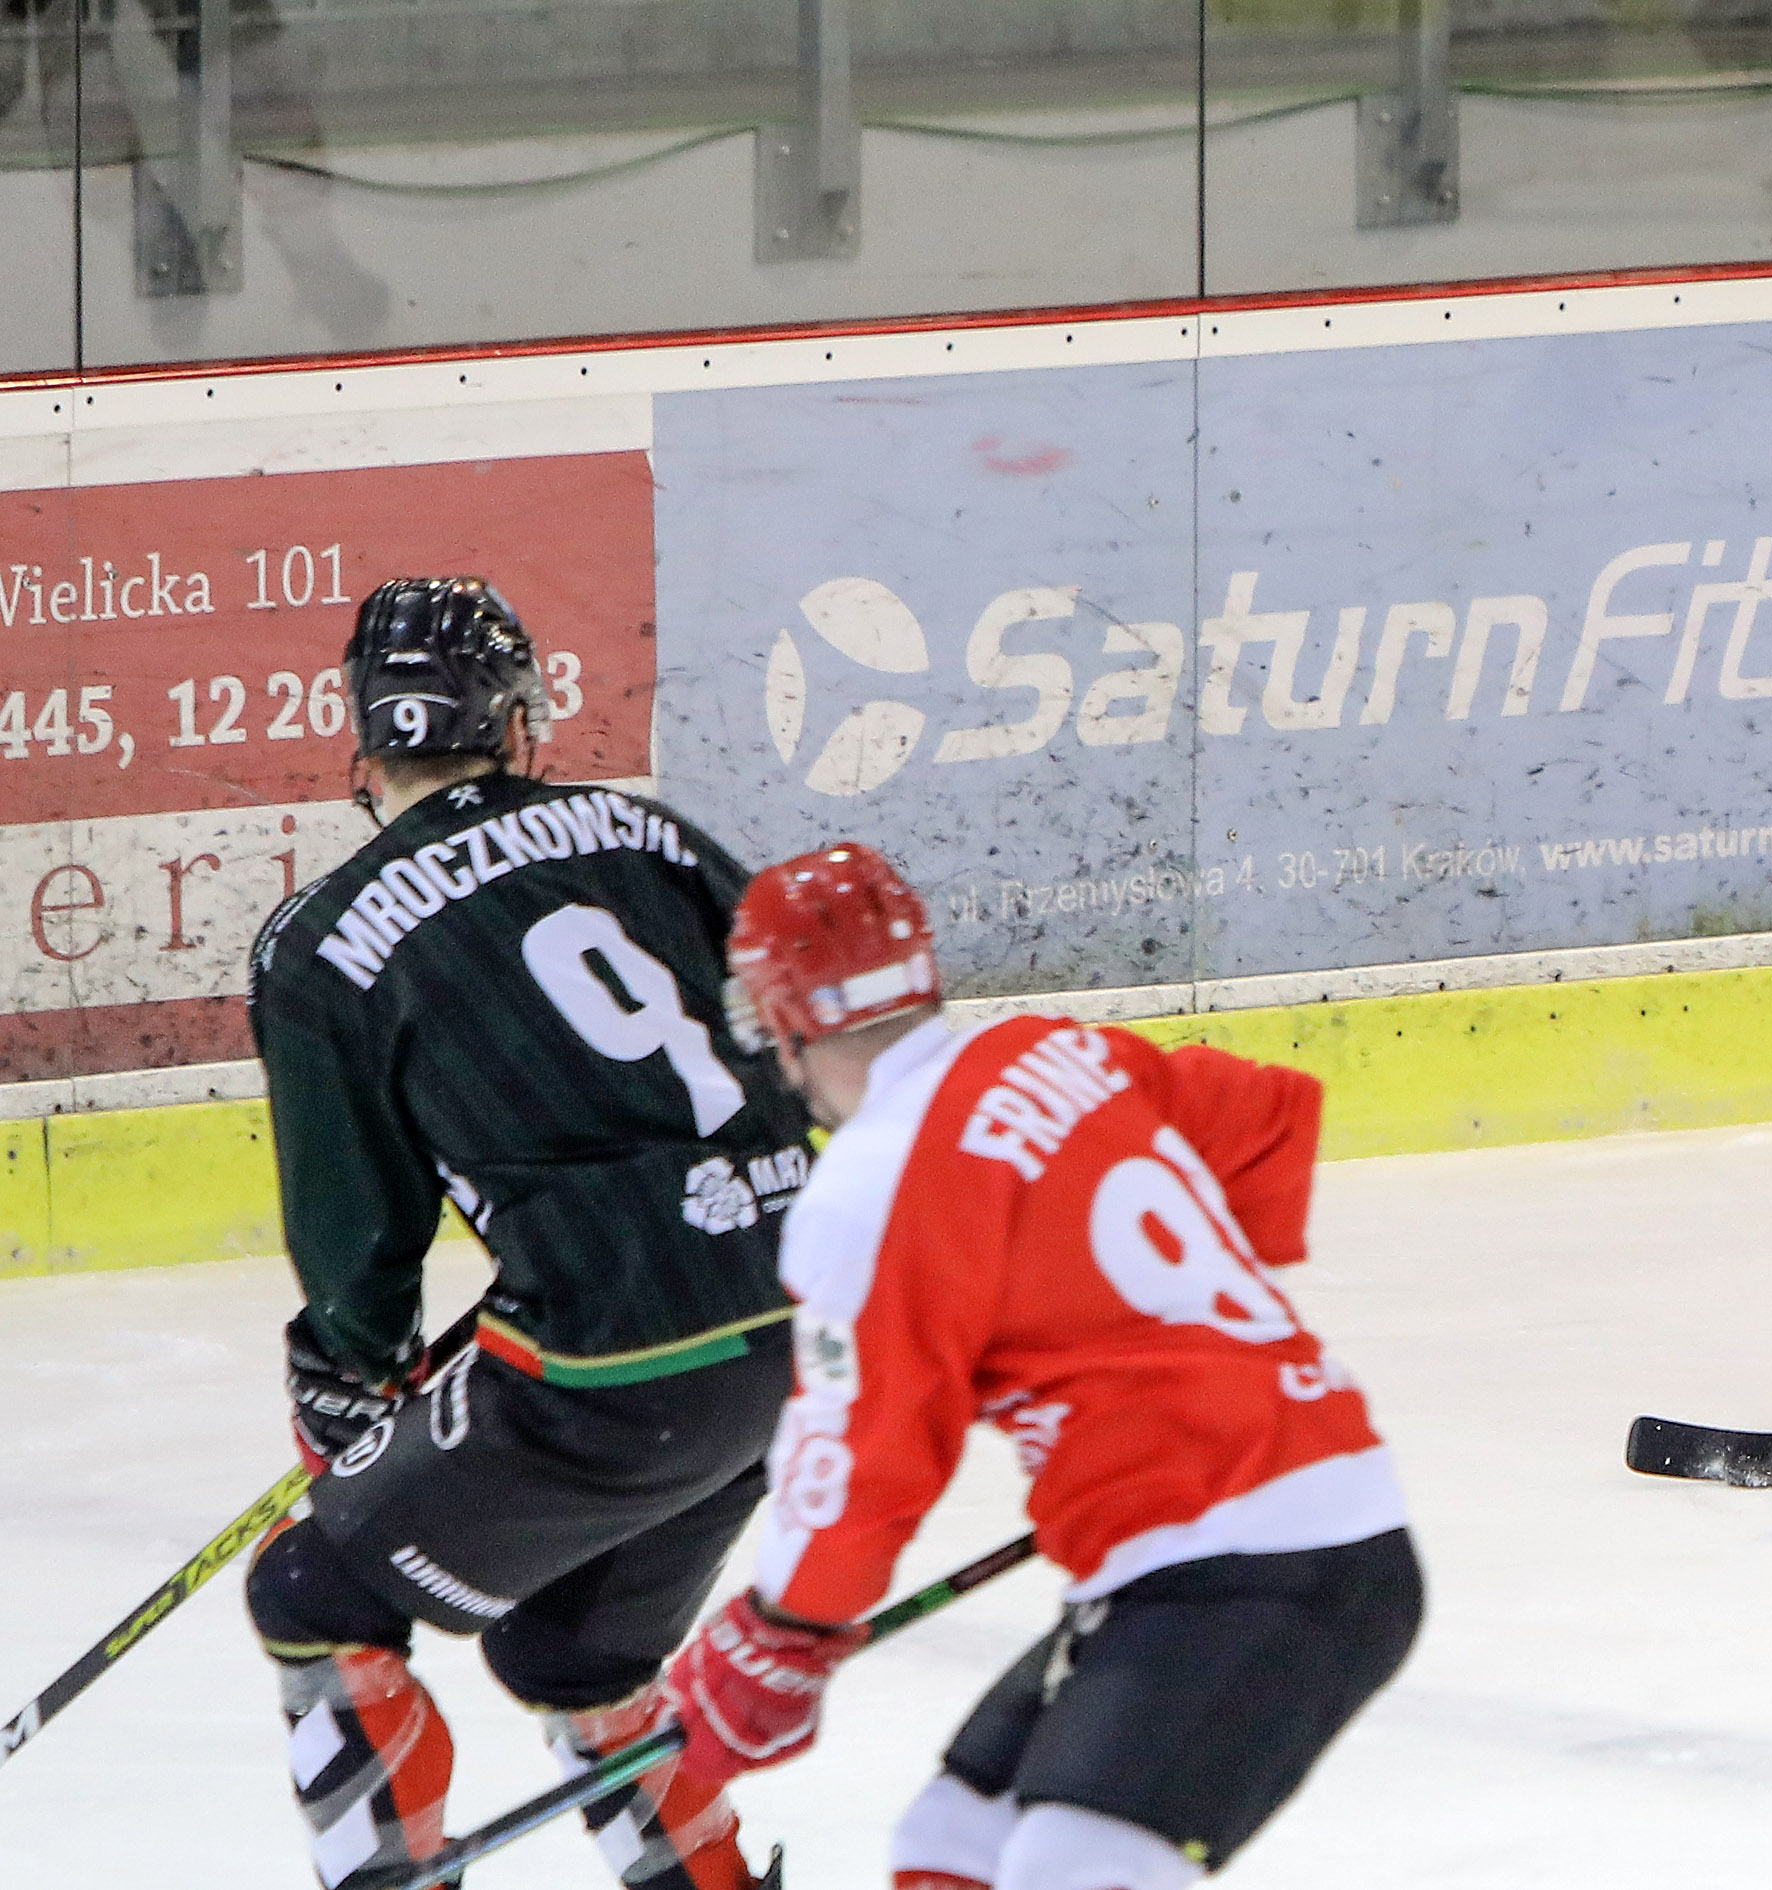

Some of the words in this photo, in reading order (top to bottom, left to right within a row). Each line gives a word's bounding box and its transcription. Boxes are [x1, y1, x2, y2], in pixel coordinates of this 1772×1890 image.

[246, 543, 351, 611] 101
[933, 571, 1548, 764] Saturn
[168, 675, 247, 748] 12
[392, 699, 429, 748] 9
[1278, 844, 1387, 890] 30-701
[521, 903, 747, 1139] 9
